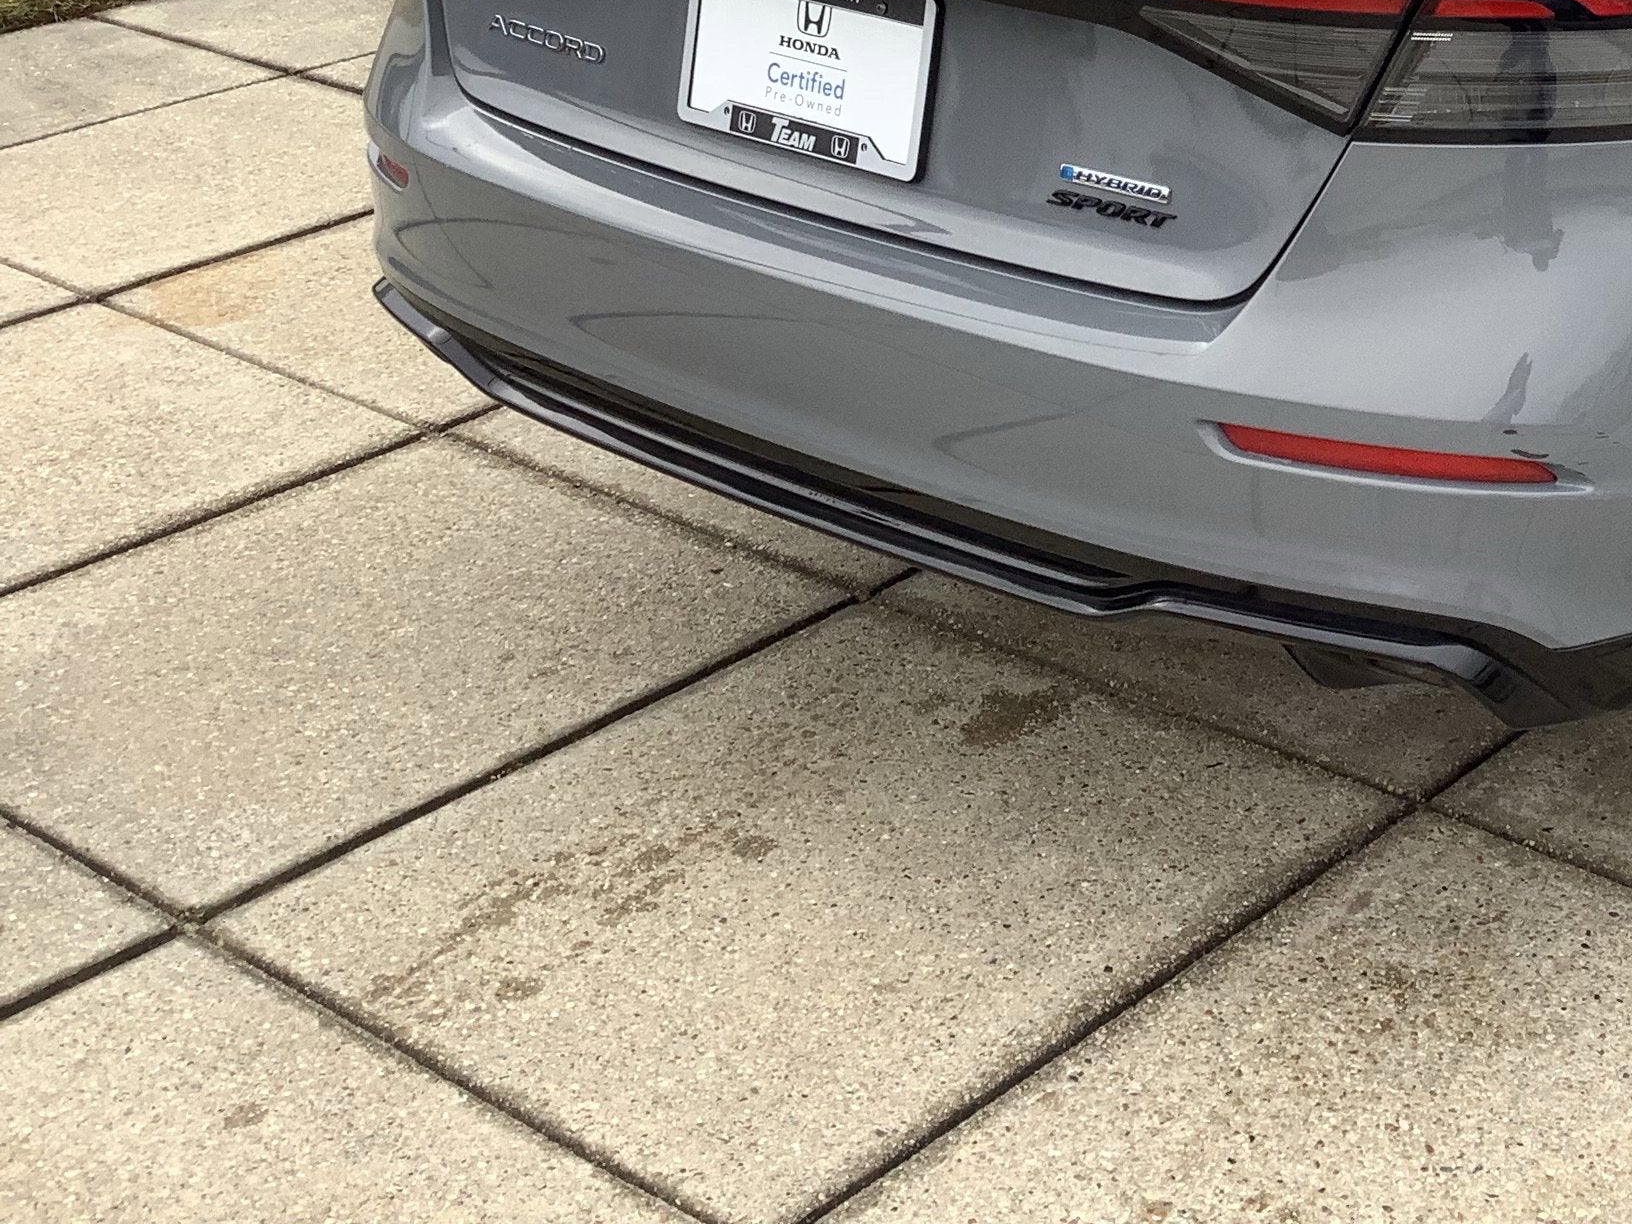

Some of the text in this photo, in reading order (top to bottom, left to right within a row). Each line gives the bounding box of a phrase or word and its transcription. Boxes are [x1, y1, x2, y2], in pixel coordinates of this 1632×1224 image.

[488, 14, 607, 64] ACCORD
[778, 34, 841, 61] HONDA
[767, 62, 846, 100] Certified
[765, 86, 842, 117] Pre-Owned
[1073, 171, 1163, 200] HYBRID
[1046, 189, 1178, 228] SPORT
